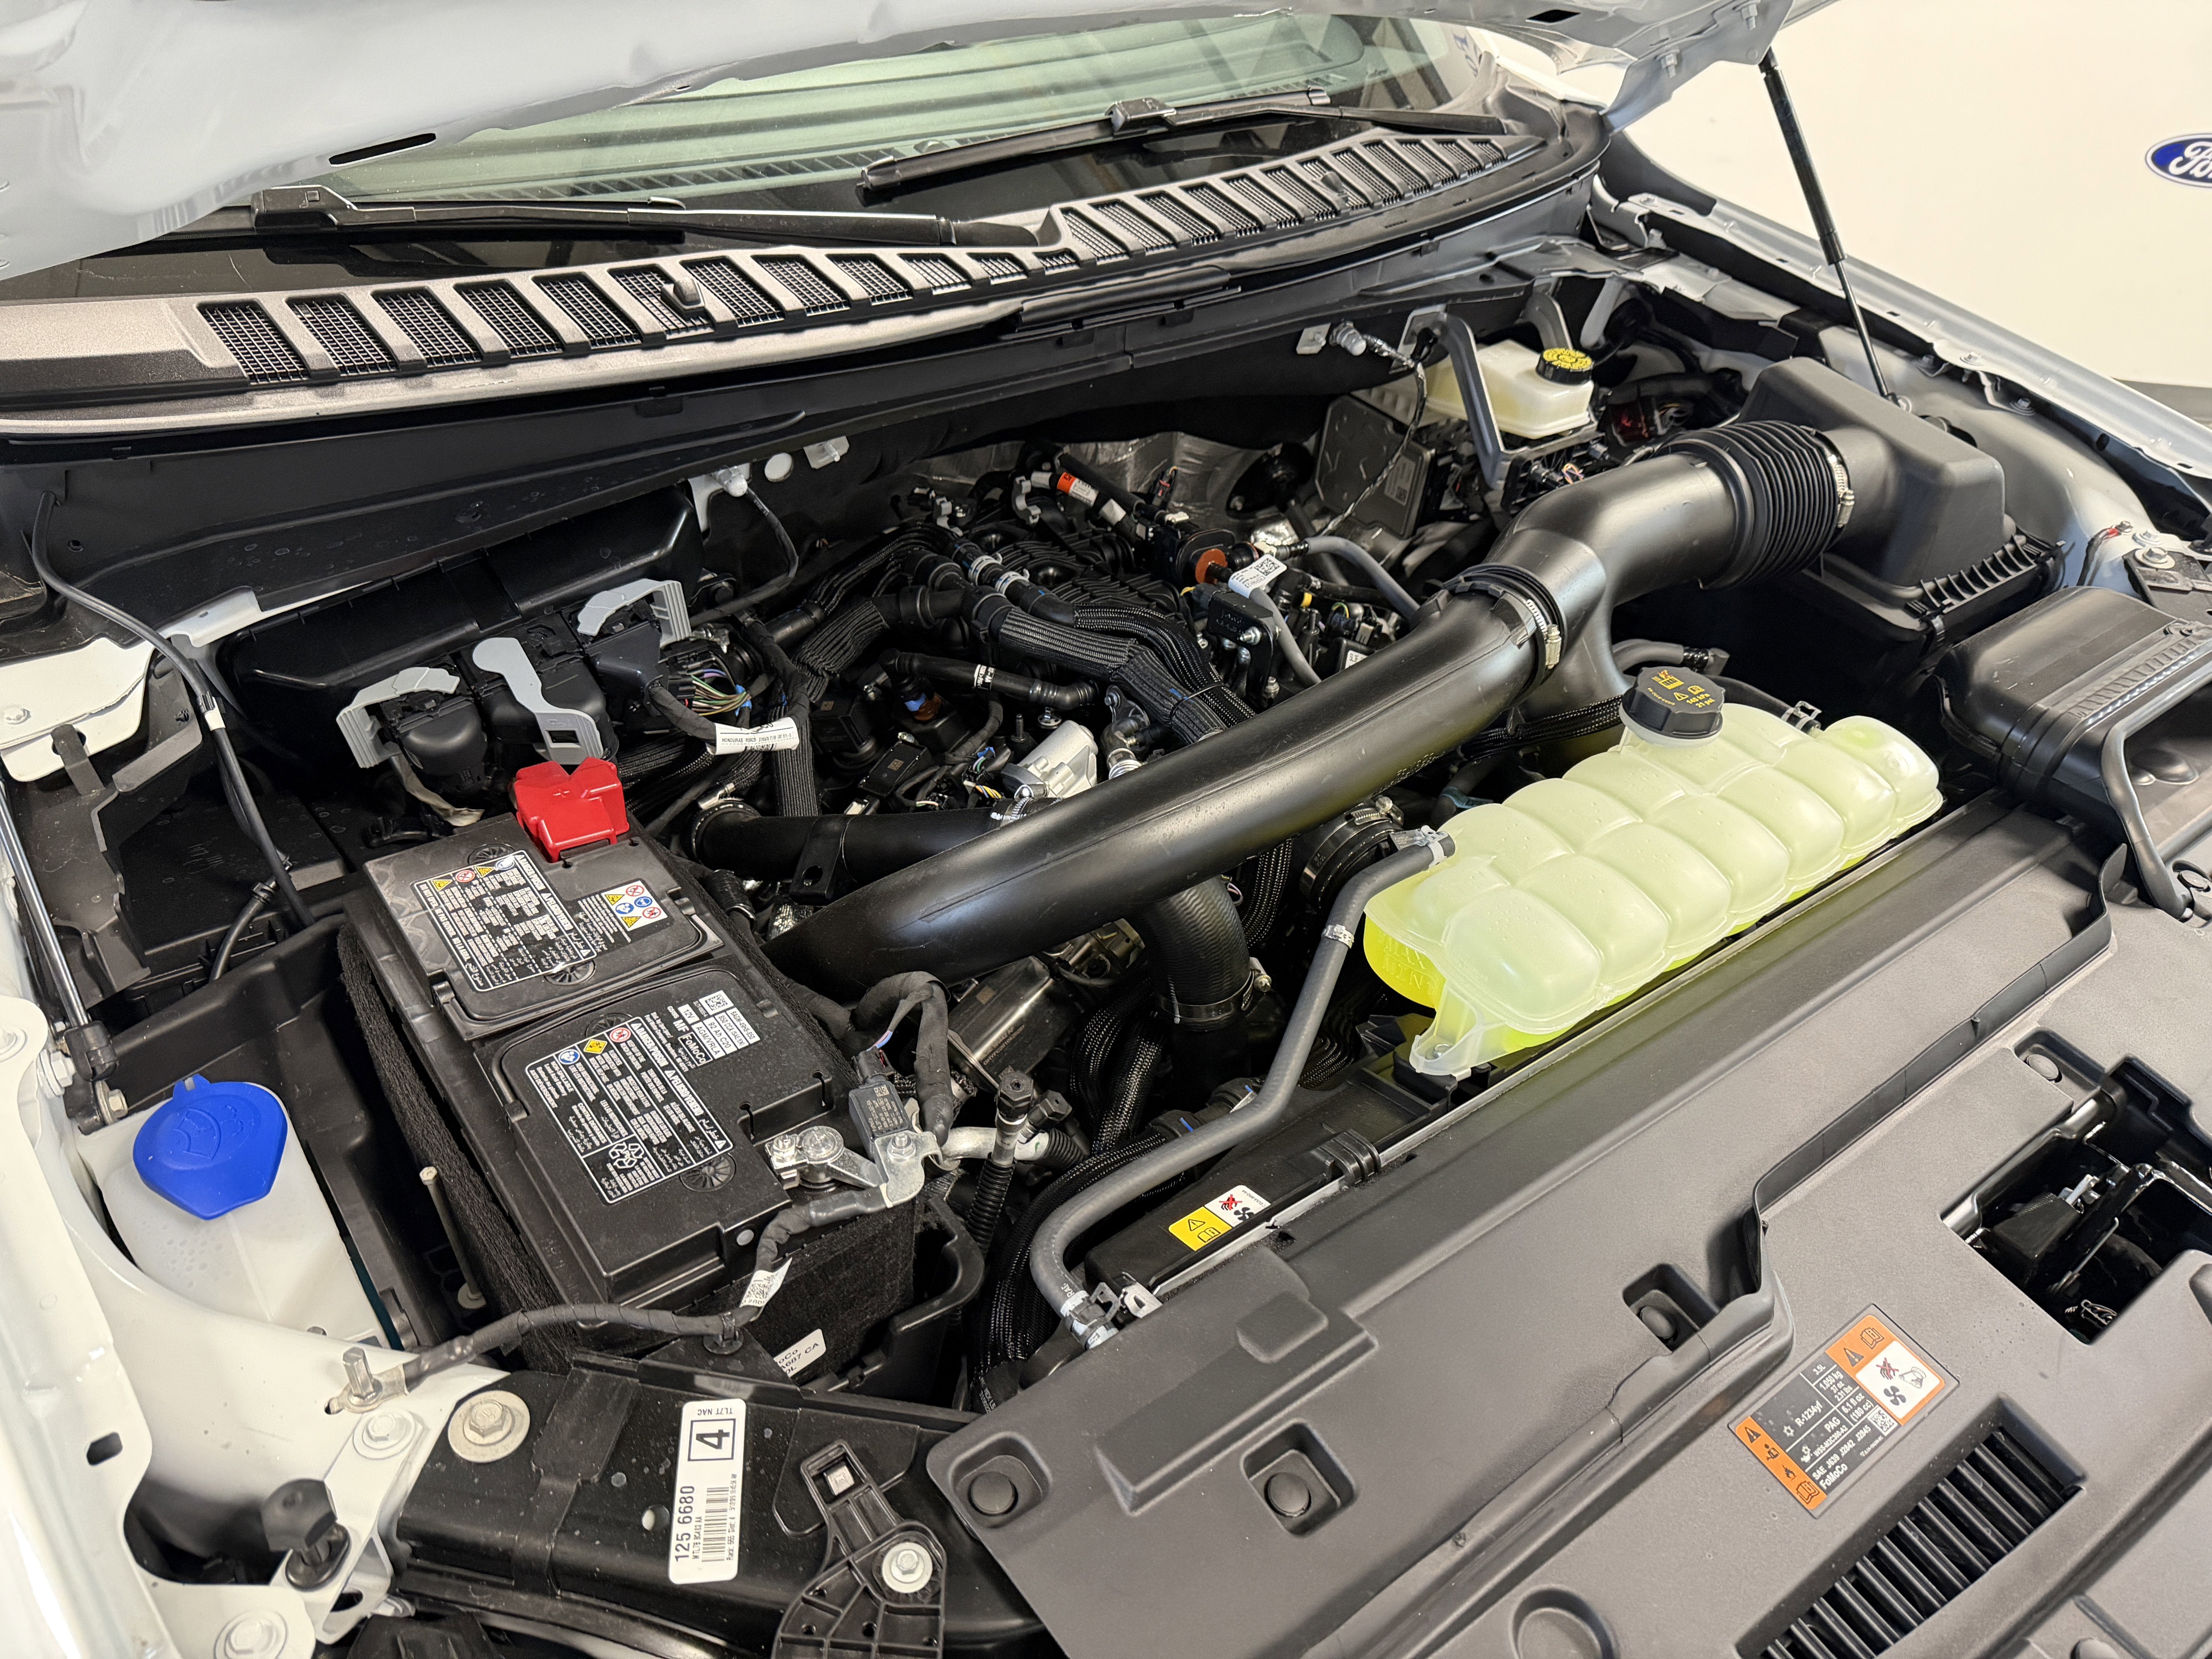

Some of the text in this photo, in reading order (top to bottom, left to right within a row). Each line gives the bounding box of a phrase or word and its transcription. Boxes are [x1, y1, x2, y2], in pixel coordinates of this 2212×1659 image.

[2169, 141, 2212, 178] Fo
[684, 1009, 695, 1018] 12V
[673, 1019, 689, 1032] MF
[635, 1028, 668, 1066] DANGER/POISON
[682, 1034, 706, 1063] FoMoCo
[696, 1026, 720, 1054] AGM/VRLA
[720, 1037, 731, 1048] C20
[670, 1075, 703, 1115] PELIGRO/VENENO
[622, 1150, 630, 1159] Pb
[778, 1349, 798, 1364] oCo
[805, 1343, 819, 1353] CA
[785, 1366, 796, 1375] OL
[1813, 1364, 1826, 1375] 3.5L
[1819, 1370, 1843, 1390] 1.050 kg
[1830, 1385, 1838, 1393] 37
[1834, 1385, 1853, 1401] 2.31 lbs
[1841, 1393, 1864, 1413] 6.1 fl oz
[1795, 1400, 1822, 1426] R-1234yf
[1850, 1399, 1874, 1422] (180 cc)
[1824, 1417, 1840, 1432] PAG
[696, 1429, 730, 1449] 4
[1813, 1425, 1848, 1456] WSS-M2C300-A2
[1812, 1466, 1827, 1480] SAE
[1826, 1454, 1839, 1468] J639
[1839, 1439, 1855, 1456] J2842
[1855, 1425, 1871, 1441] J2845
[1819, 1463, 1847, 1489] FoMoCo
[675, 1486, 694, 1561] 125 6680
